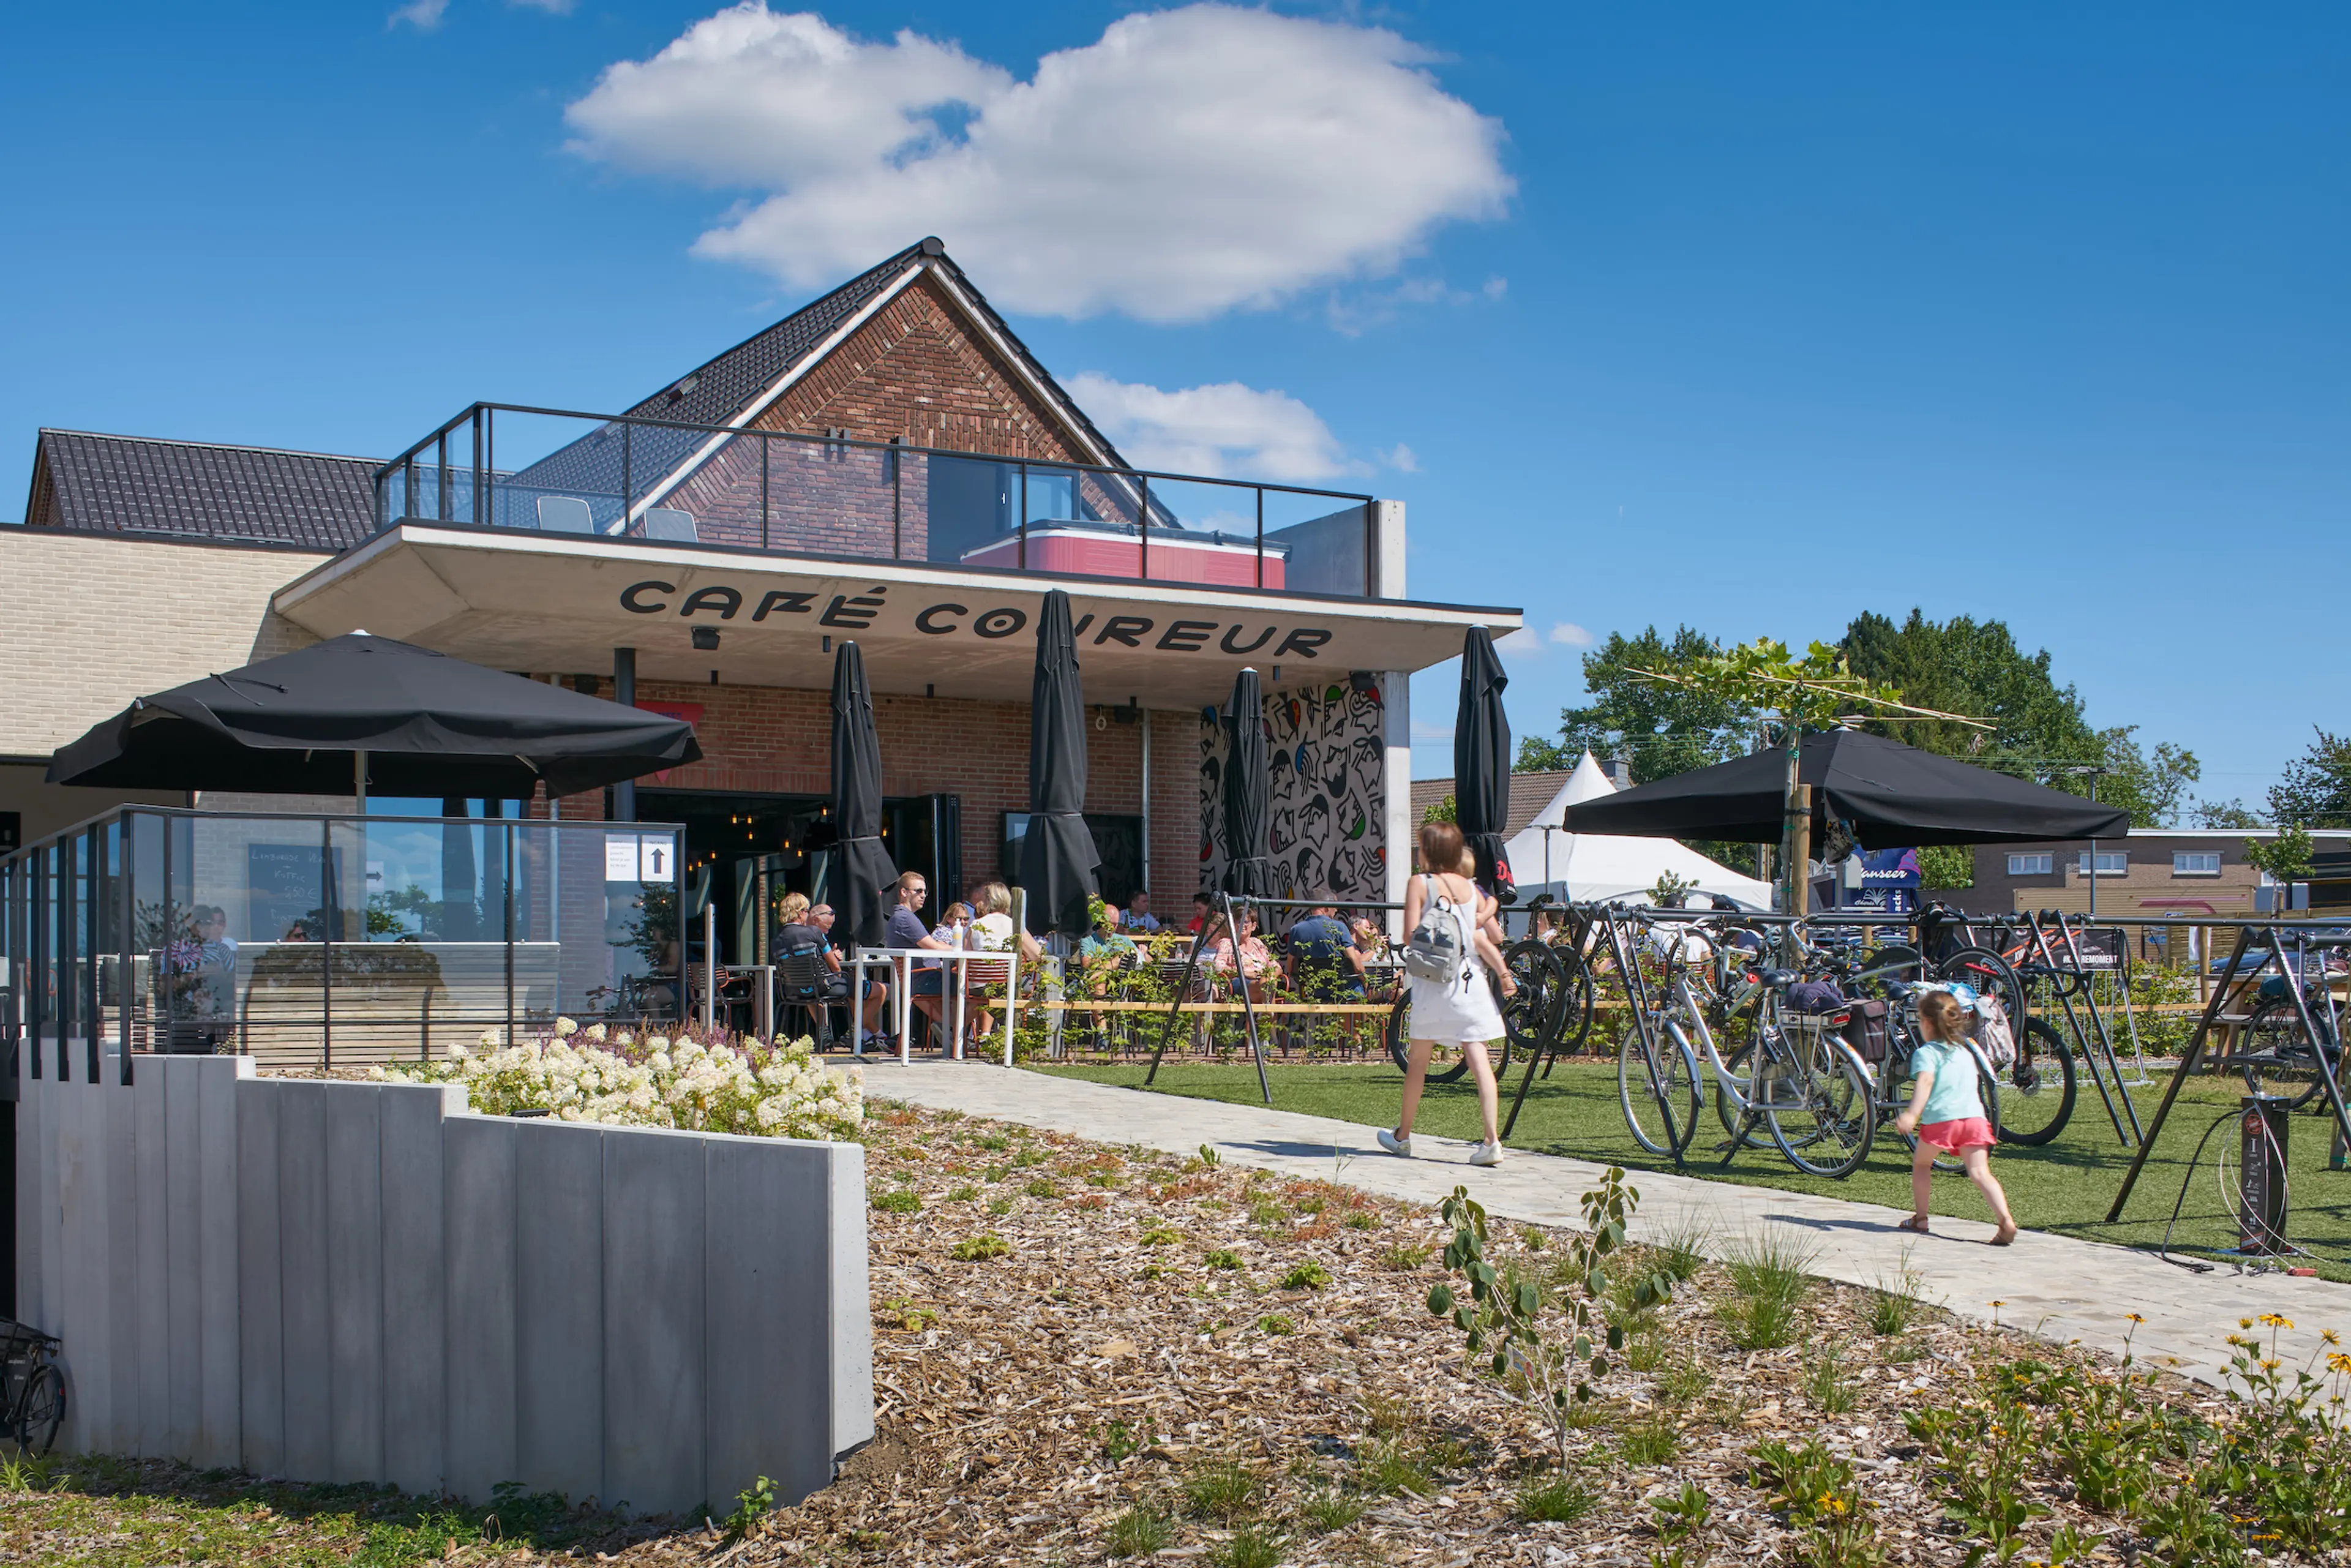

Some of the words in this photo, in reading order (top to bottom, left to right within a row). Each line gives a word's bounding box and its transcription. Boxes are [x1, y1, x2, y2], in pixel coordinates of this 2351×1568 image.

[619, 580, 887, 629] CAFÉ
[1861, 867, 1908, 879] anseer
[2063, 954, 2118, 964] #KREMOMENT
